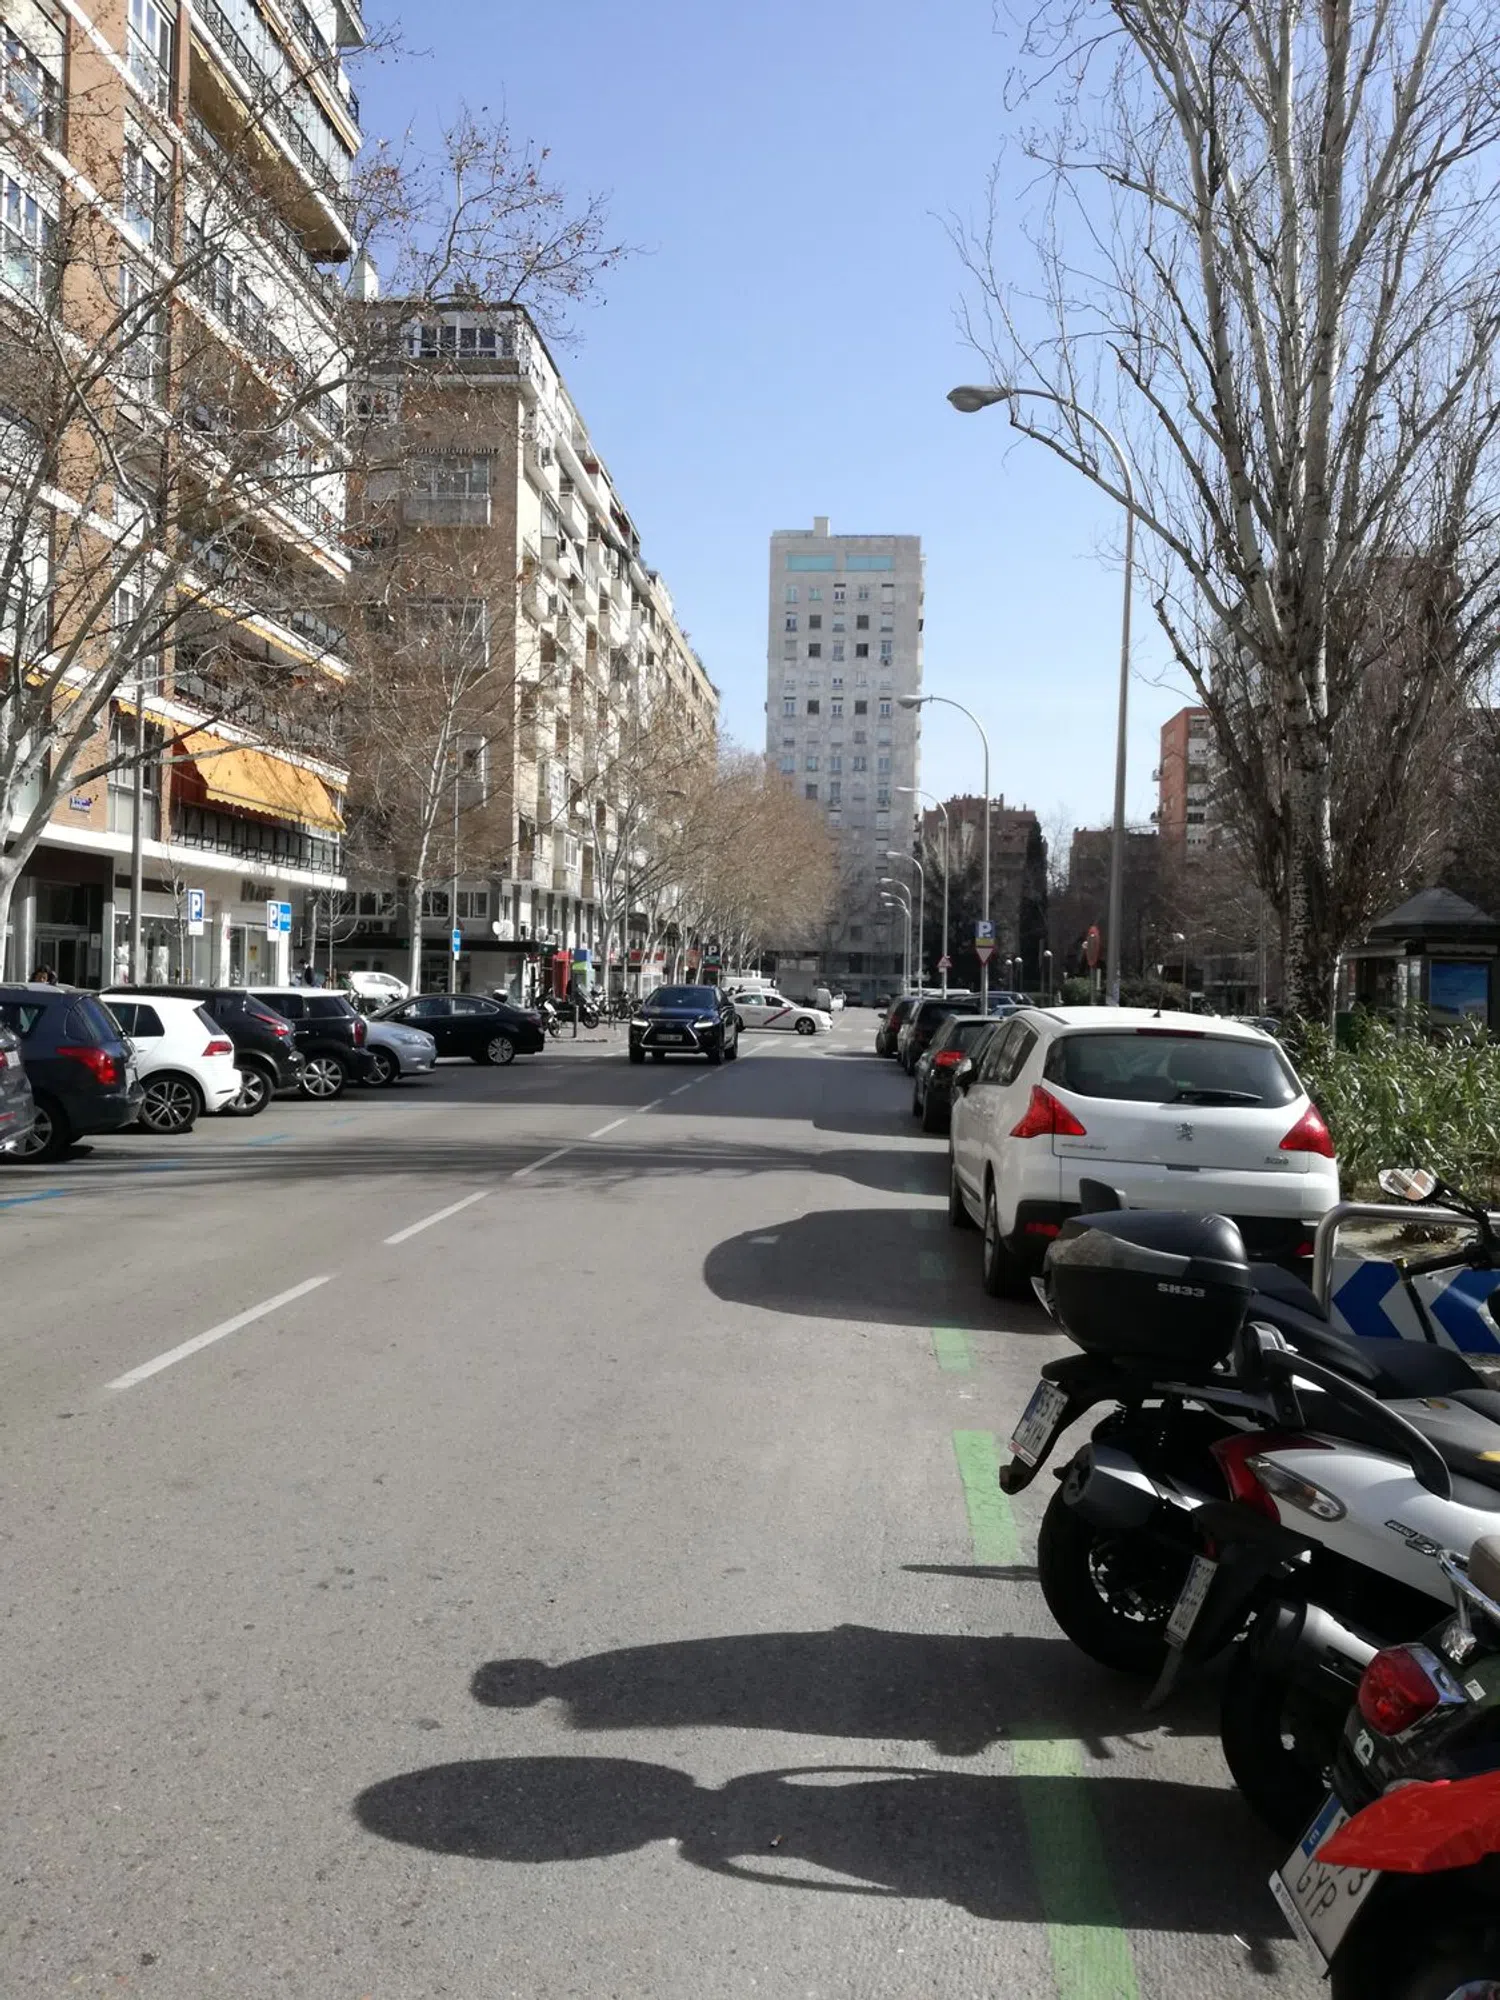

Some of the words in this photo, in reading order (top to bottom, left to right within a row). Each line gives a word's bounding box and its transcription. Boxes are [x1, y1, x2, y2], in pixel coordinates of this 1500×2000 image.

[191, 893, 202, 920] P
[269, 904, 278, 928] P
[979, 921, 992, 938] P
[708, 945, 718, 956] P
[1157, 1282, 1206, 1298] SH33
